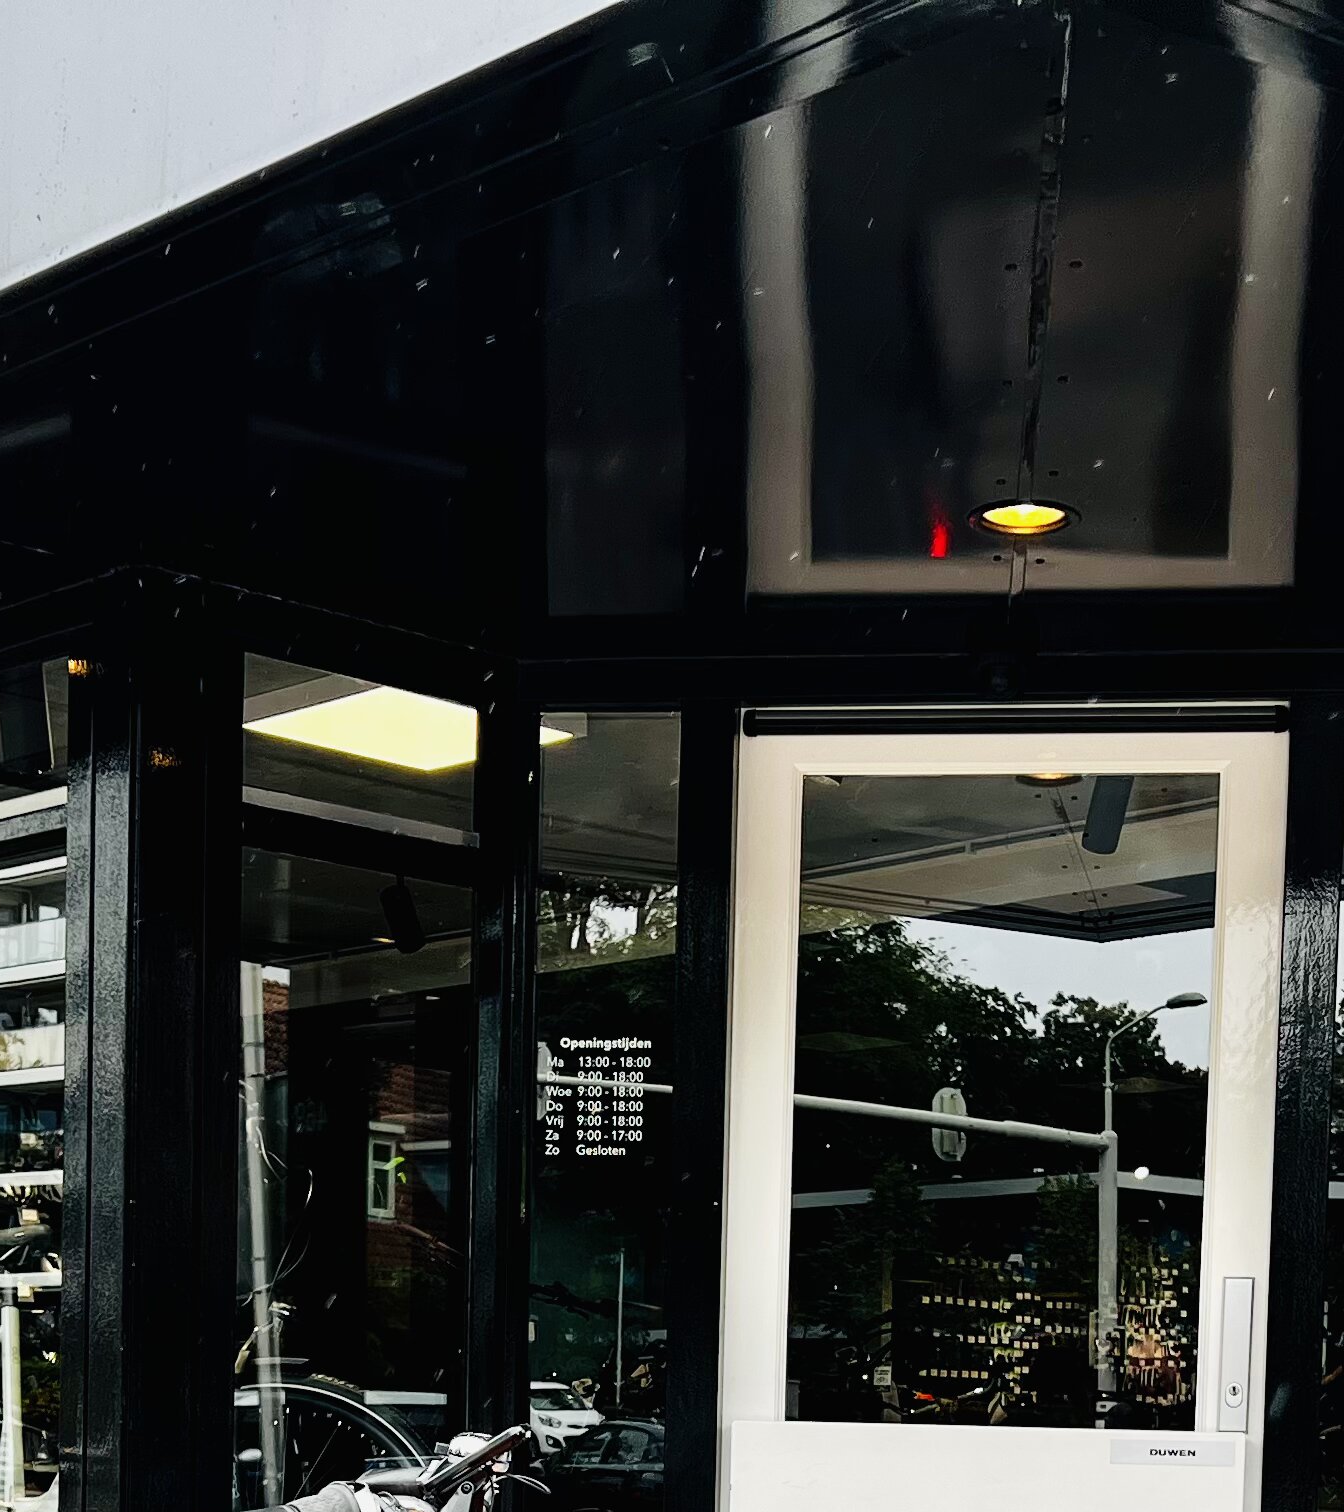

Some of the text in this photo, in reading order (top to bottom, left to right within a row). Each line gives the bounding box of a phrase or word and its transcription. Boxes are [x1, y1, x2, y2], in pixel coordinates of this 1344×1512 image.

[560, 1037, 651, 1051] Openingstijden
[547, 1057, 564, 1067] Ma
[579, 1057, 609, 1067] 13:00
[620, 1057, 651, 1067] 18:00
[577, 1071, 602, 1082] 9:00
[613, 1071, 643, 1082] 18:00
[545, 1086, 572, 1096] Woe
[577, 1086, 602, 1097] 9:00
[612, 1086, 643, 1097] 18:00
[546, 1101, 563, 1111] Do
[577, 1101, 602, 1112] 9:00
[612, 1101, 643, 1112] 18:00
[546, 1115, 564, 1128] Vrij
[577, 1115, 601, 1126] 9:00
[612, 1115, 643, 1126] 18:00
[545, 1130, 559, 1141] Za
[576, 1130, 601, 1141] 9:00
[612, 1130, 642, 1141] 17:00
[545, 1144, 626, 1156] Zo Gesloten
[1149, 1449, 1196, 1457] DUWEN
